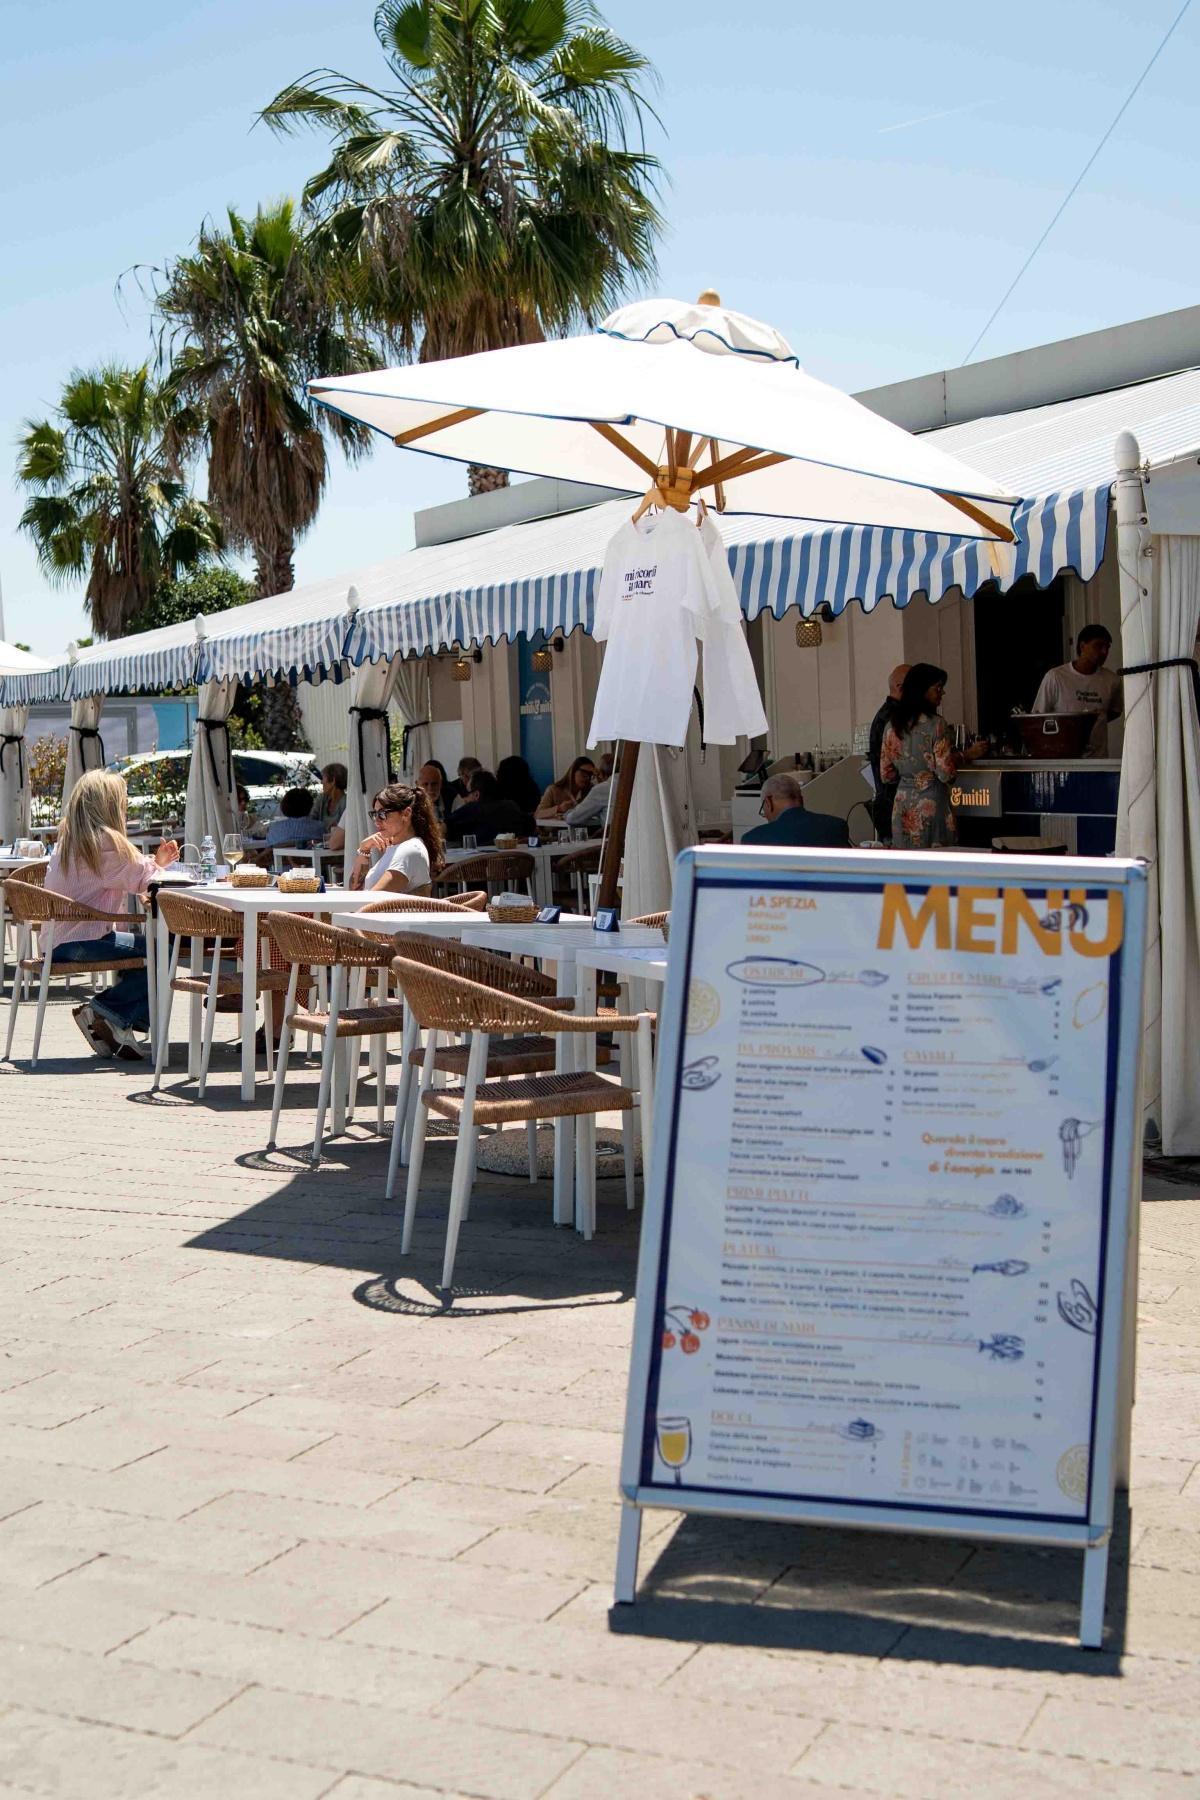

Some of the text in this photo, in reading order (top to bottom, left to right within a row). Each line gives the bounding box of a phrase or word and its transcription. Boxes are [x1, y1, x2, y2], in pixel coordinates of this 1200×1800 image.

[749, 896, 817, 910] LA SPEZIA
[877, 883, 1124, 957] MENU
